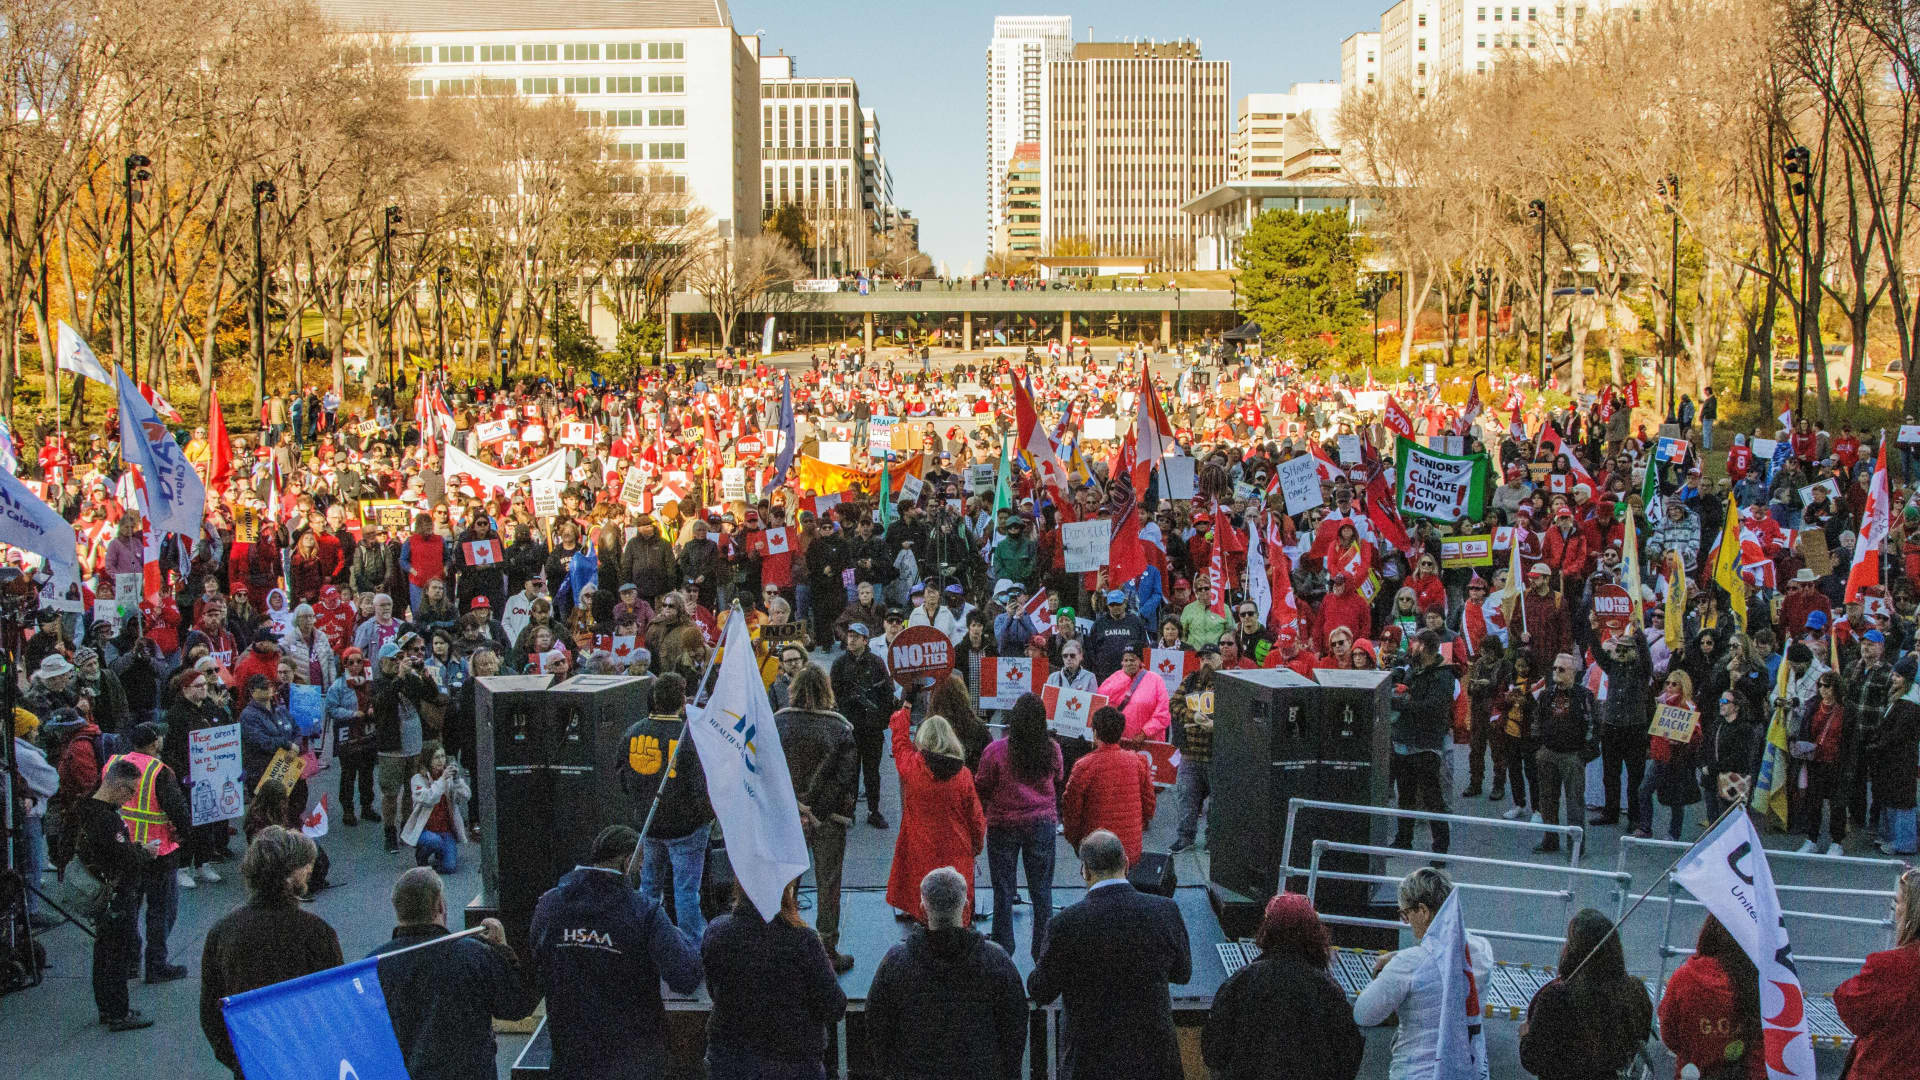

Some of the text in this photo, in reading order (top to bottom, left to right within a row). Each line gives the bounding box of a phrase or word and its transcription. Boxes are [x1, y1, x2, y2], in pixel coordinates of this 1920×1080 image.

[359, 421, 376, 432] NO!
[871, 429, 890, 437] LIVE
[870, 440, 890, 448] MATTE
[1282, 460, 1311, 480] SHAME
[1411, 452, 1460, 474] SENIORS
[1408, 470, 1457, 493] CLIMATE
[1427, 470, 1443, 481] for
[1406, 483, 1451, 505] ACTION
[1403, 495, 1438, 513] NOW
[6, 510, 45, 536] Calgary
[1594, 597, 1613, 612] NO
[893, 640, 948, 668] NO TWO
[924, 652, 948, 666] TIER
[1662, 707, 1693, 721] FIGHT
[708, 718, 736, 744] HEALTH
[1658, 717, 1689, 732] BACK!
[191, 731, 212, 742] These
[191, 745, 204, 753] the
[564, 928, 613, 947] HSAA
